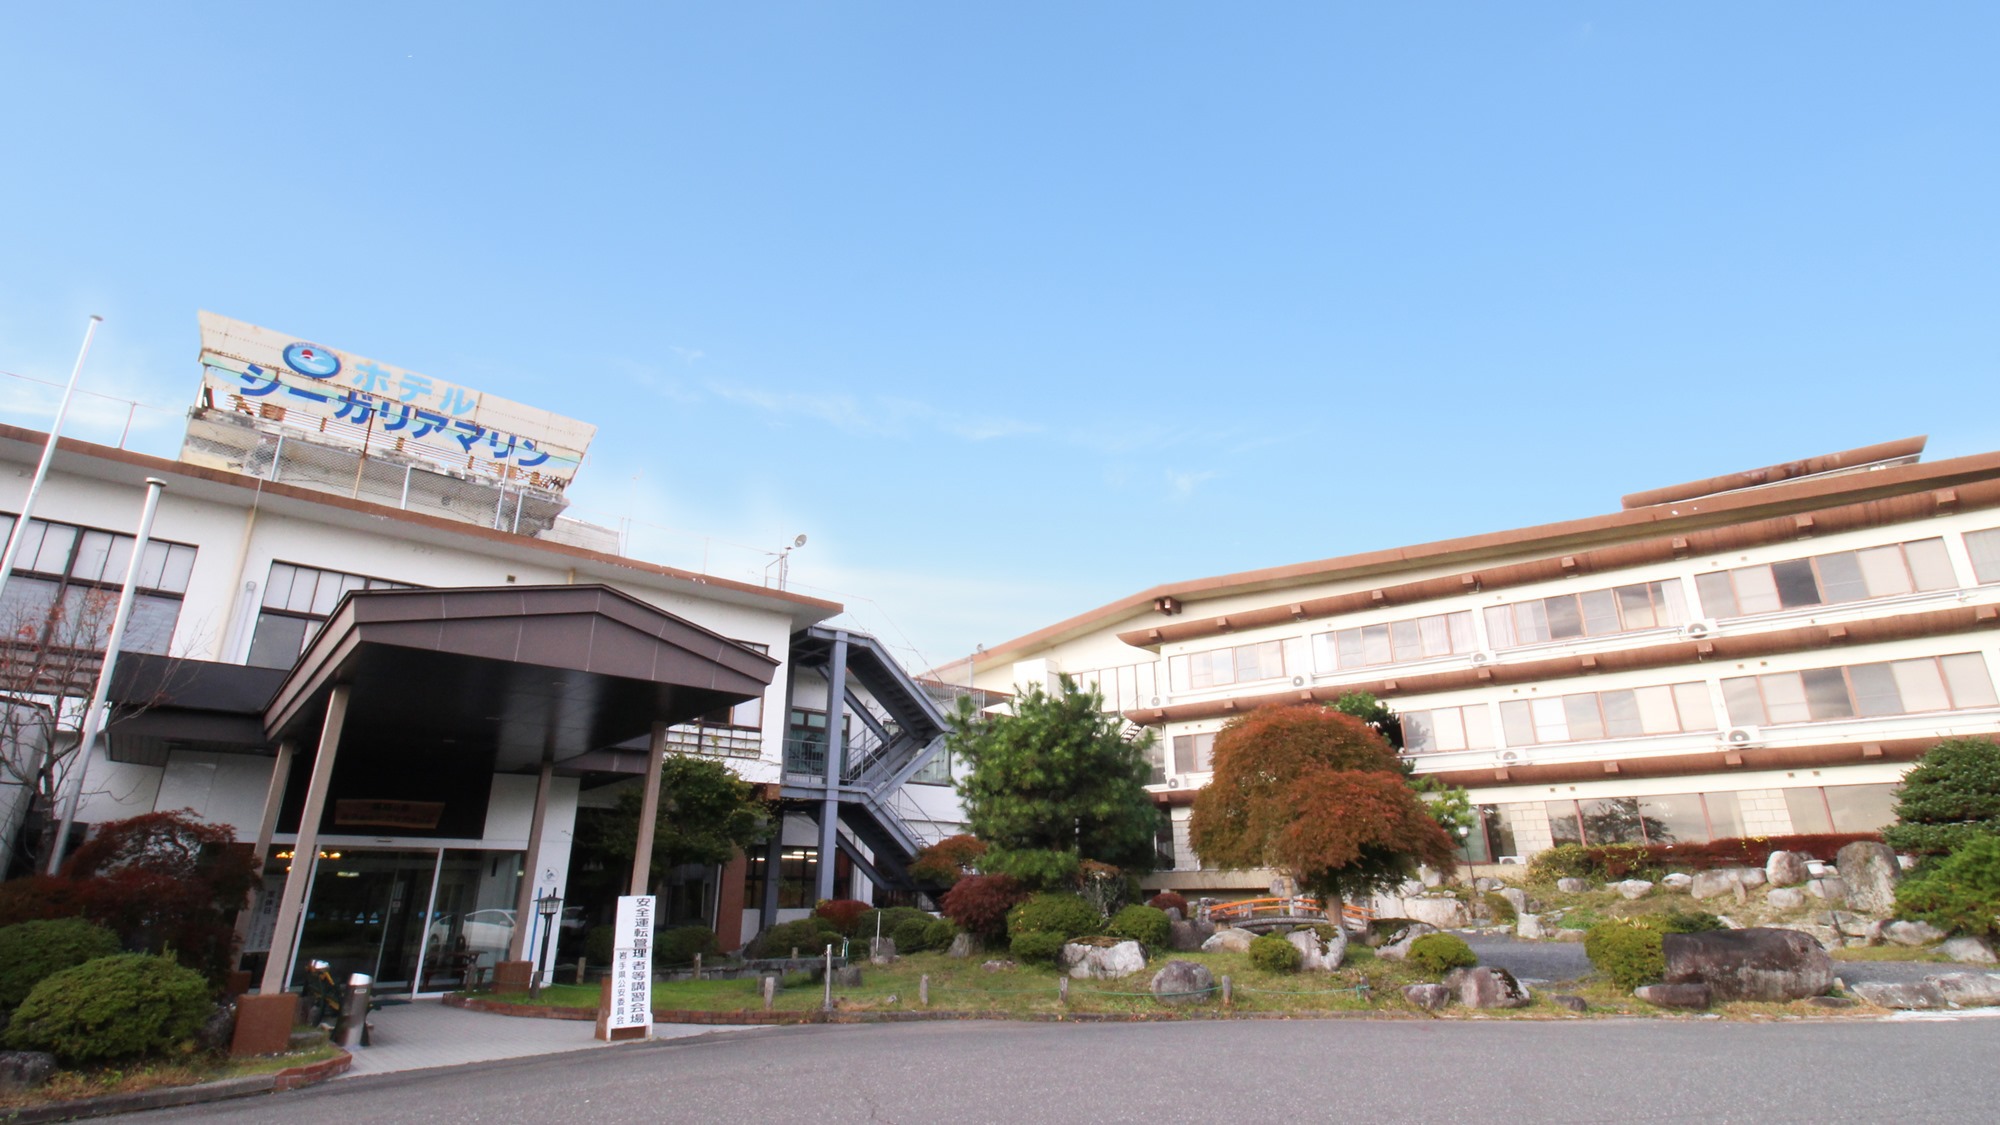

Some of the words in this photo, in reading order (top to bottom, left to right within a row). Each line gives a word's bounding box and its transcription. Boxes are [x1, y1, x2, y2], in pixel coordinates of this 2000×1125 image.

[240, 364, 551, 467] シーガリアマリン
[353, 362, 475, 415] ホテル
[616, 951, 627, 1025] 岩手県公安委員会
[630, 897, 650, 1024] 安全運転管理者等講習会場
